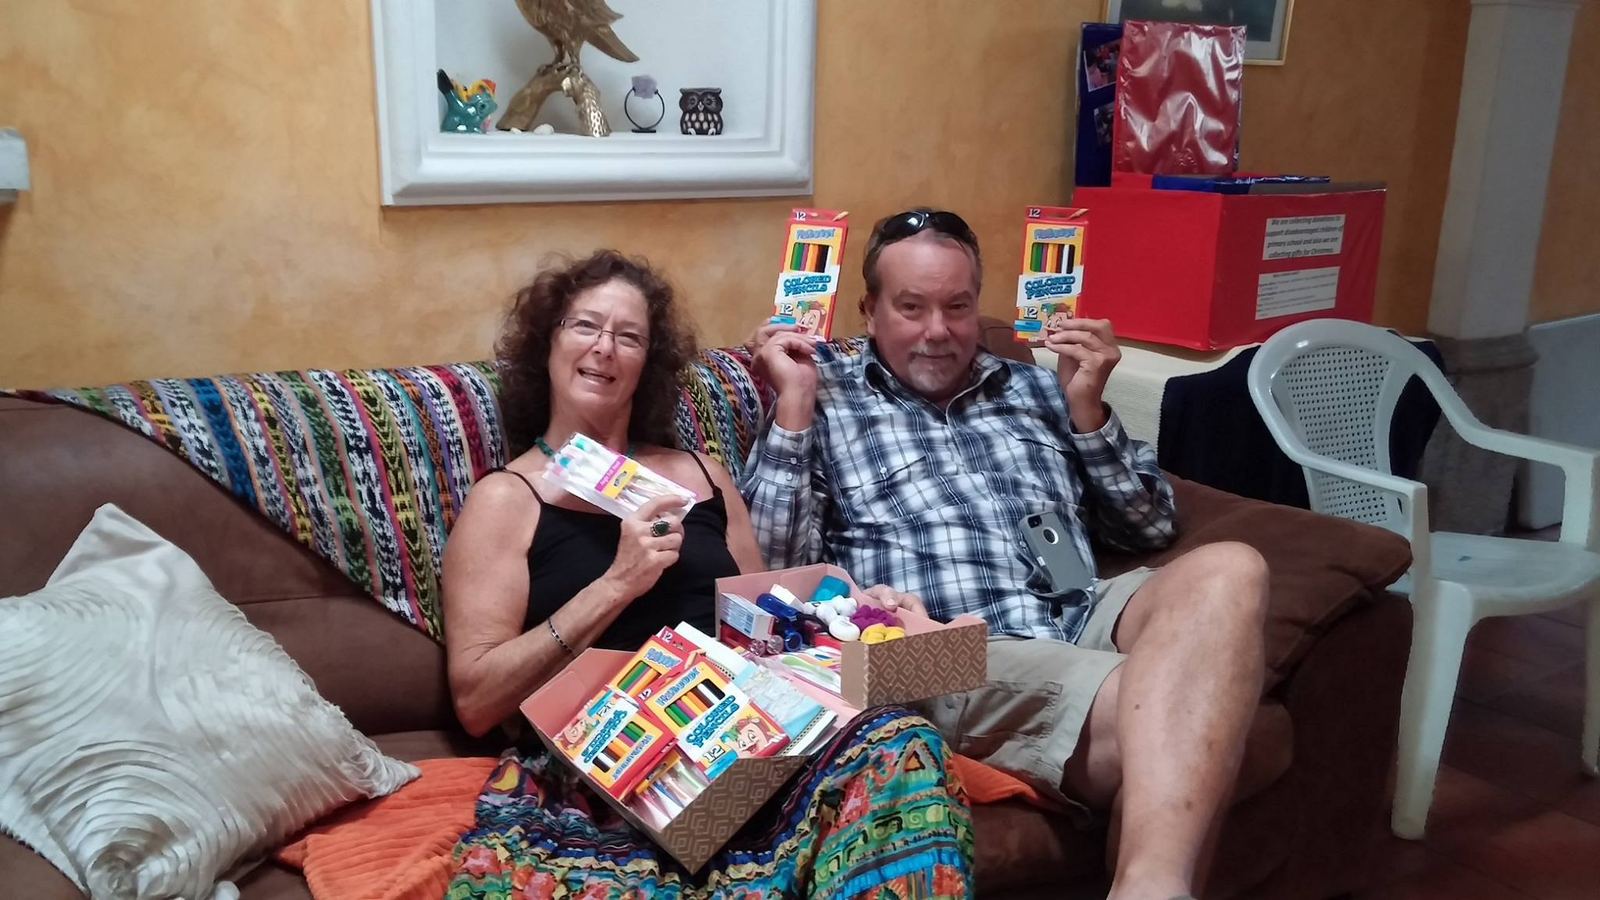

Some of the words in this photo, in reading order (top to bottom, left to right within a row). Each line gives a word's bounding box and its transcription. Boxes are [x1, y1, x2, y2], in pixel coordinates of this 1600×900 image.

[795, 211, 807, 221] 12
[1028, 208, 1041, 218] 12
[783, 275, 832, 288] COLORED
[1024, 276, 1076, 291] COLORED
[783, 284, 828, 296] PENCILS
[1025, 285, 1072, 299] PENCILS
[780, 303, 794, 316] 12
[1023, 306, 1038, 319] 12
[661, 630, 673, 643] 12
[638, 688, 652, 701] 12
[686, 695, 736, 743] COLORED
[693, 702, 740, 748] PENCILS
[581, 710, 620, 756] PENCILS
[583, 711, 627, 763] COLORED
[703, 744, 726, 763] 12
